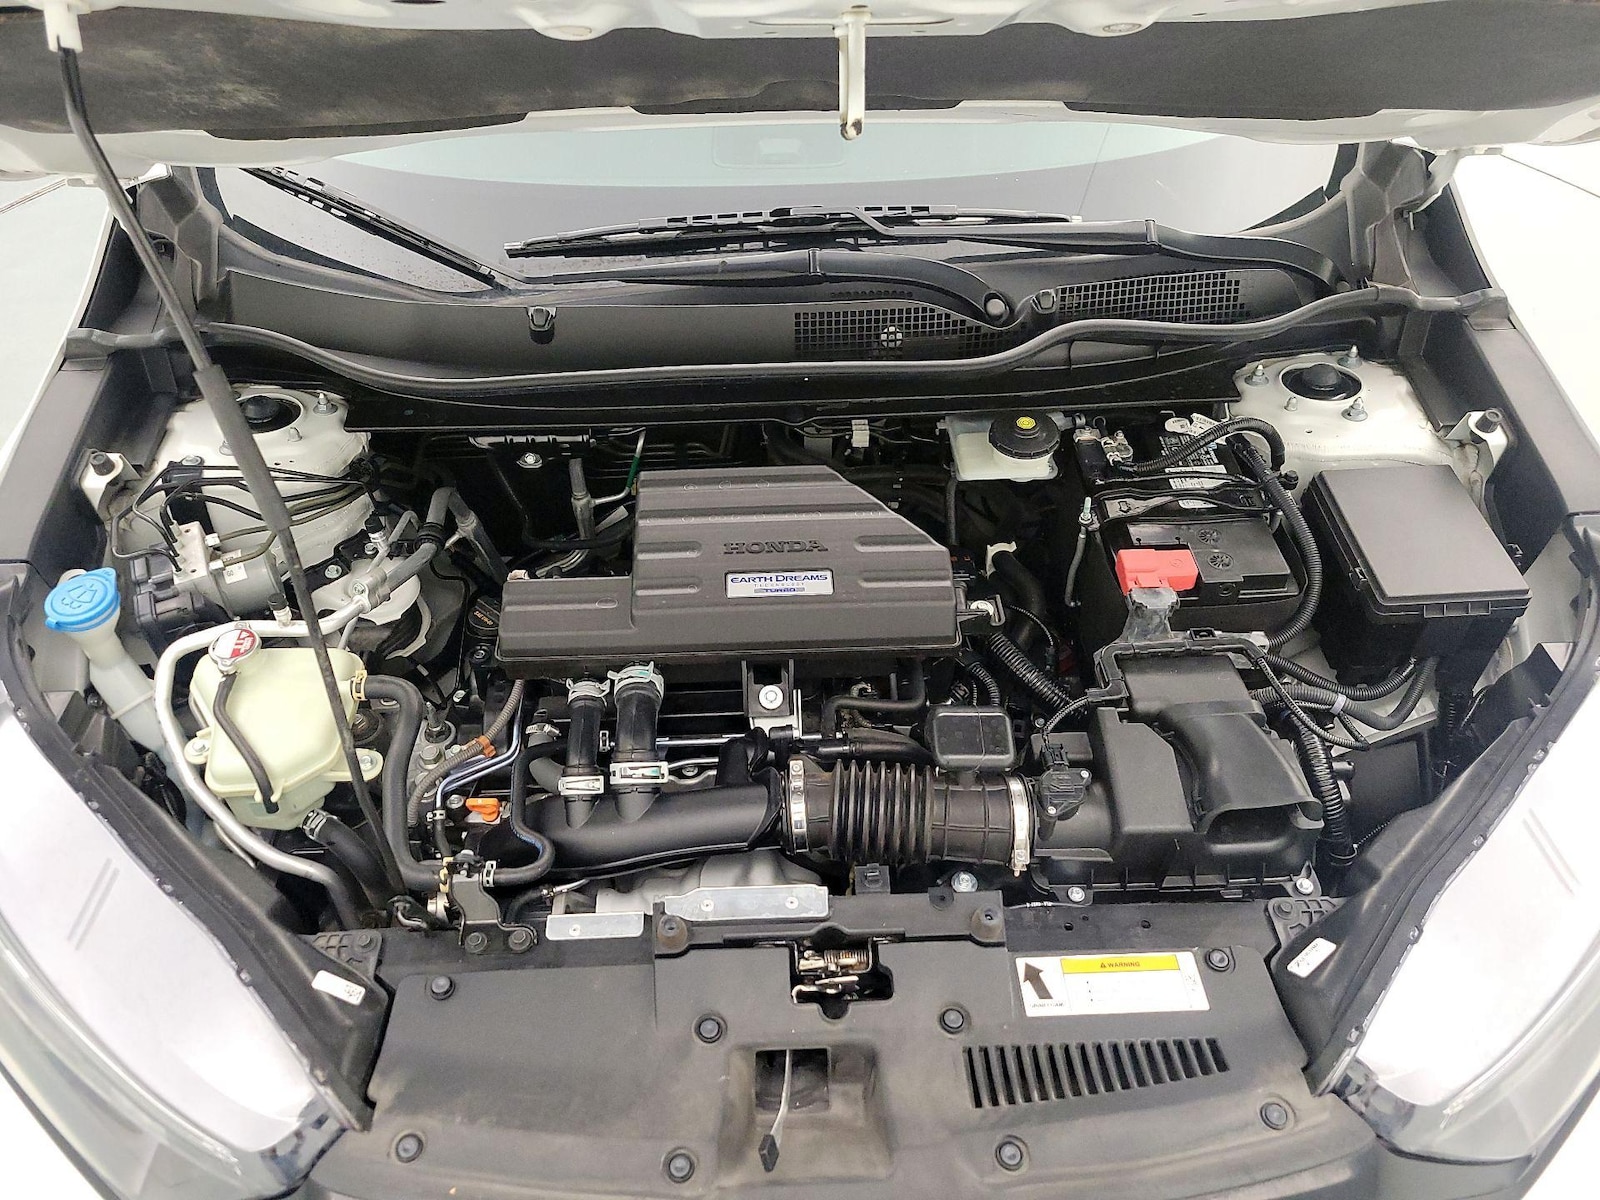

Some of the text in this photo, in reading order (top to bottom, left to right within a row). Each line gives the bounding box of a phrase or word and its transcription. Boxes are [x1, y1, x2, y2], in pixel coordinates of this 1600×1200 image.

[723, 540, 829, 555] HONDA
[730, 574, 828, 584] EARTH DREAMS
